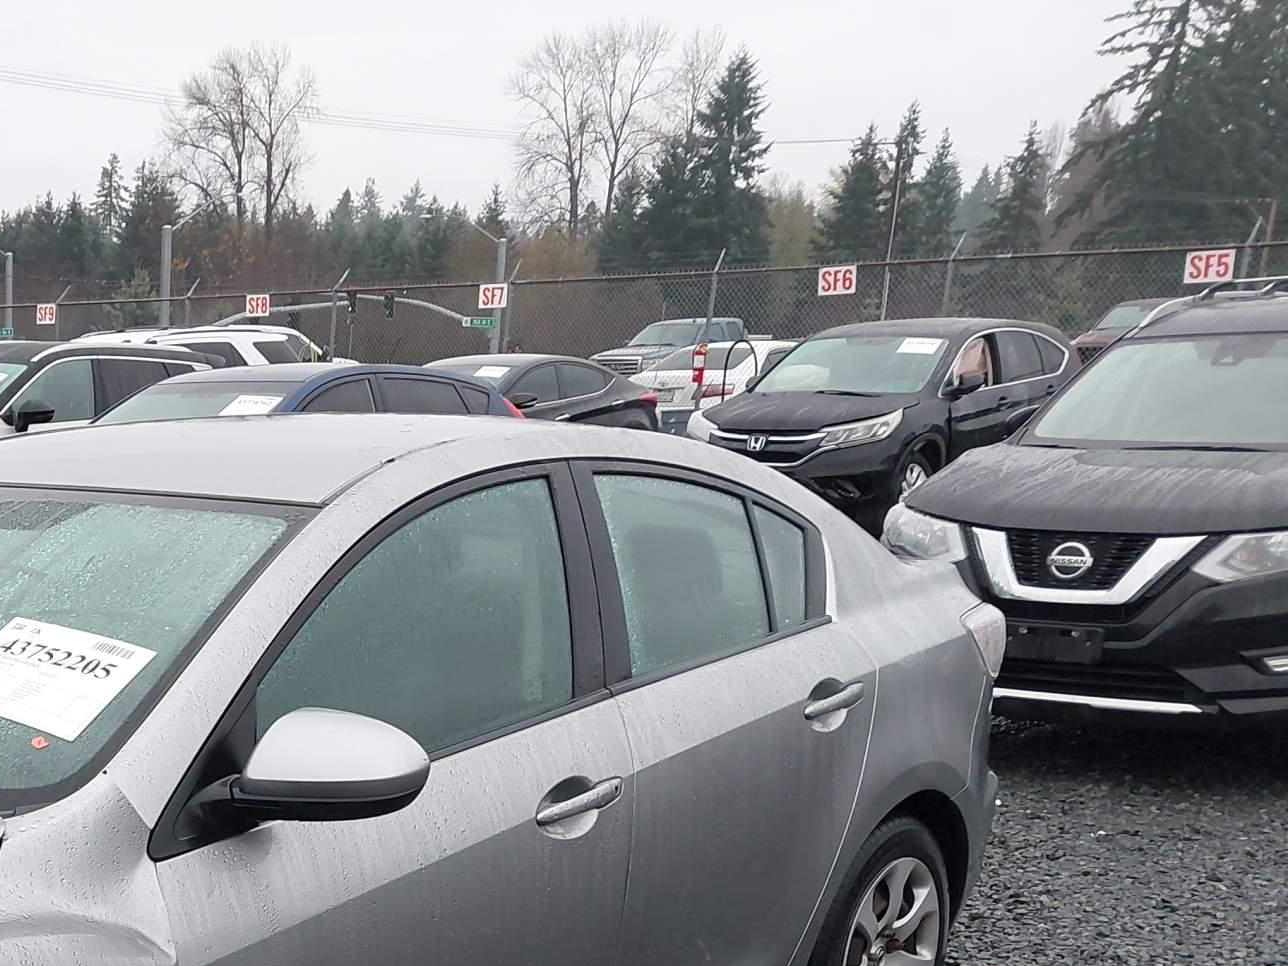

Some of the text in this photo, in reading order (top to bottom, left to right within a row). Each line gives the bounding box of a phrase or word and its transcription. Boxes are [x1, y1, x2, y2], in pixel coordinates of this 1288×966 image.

[1189, 253, 1230, 279] SF5
[822, 269, 853, 291] SF6
[248, 296, 268, 314] SF8
[482, 287, 505, 306] SF7
[38, 306, 55, 322] SF9
[1050, 557, 1089, 566] NISSAN
[0, 639, 119, 679] 43752205
